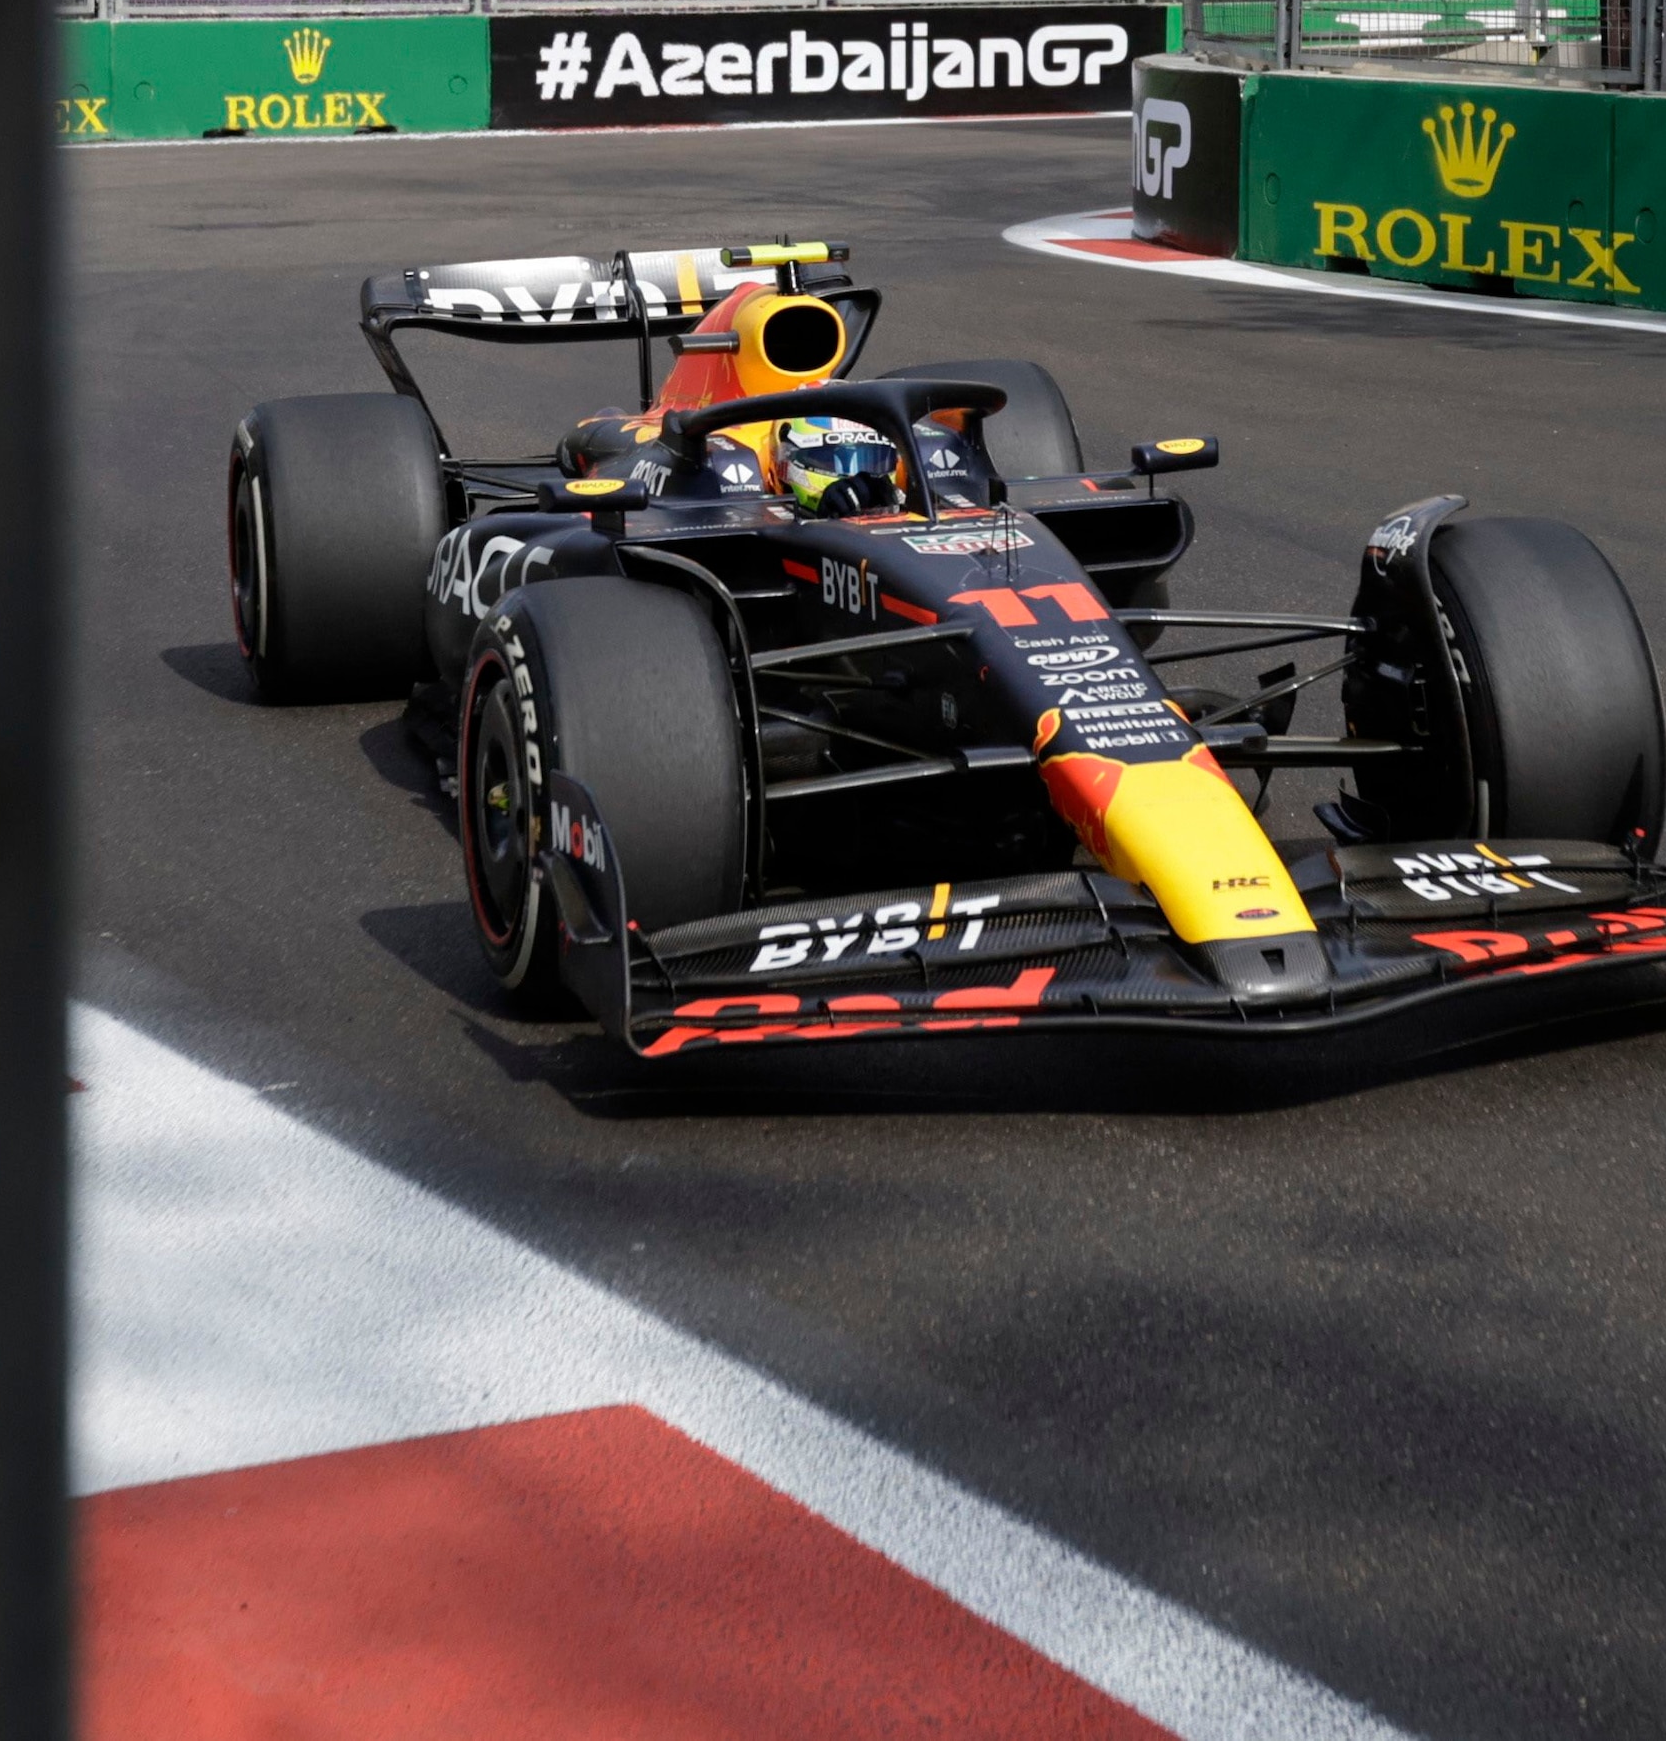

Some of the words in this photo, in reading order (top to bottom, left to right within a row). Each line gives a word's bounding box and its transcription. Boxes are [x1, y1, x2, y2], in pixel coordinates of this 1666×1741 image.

[536, 22, 1128, 101] #AzerbaijanGP
[225, 92, 386, 129] ROLEX
[1313, 201, 1641, 294] ROLEX
[821, 557, 878, 621] BYBIT
[947, 582, 1110, 627] 11
[1014, 638, 1065, 649] Cash
[1069, 635, 1110, 645] App
[1027, 649, 1099, 666] CDW
[491, 614, 513, 633] P
[505, 634, 543, 786] ZERO
[1087, 682, 1148, 696] ARCTIC
[1098, 689, 1146, 701] WOLF
[1064, 701, 1165, 720] PIRELLI
[1085, 732, 1161, 749] Mobil
[550, 800, 606, 872] Mobil
[750, 882, 1001, 972] BYBIT
